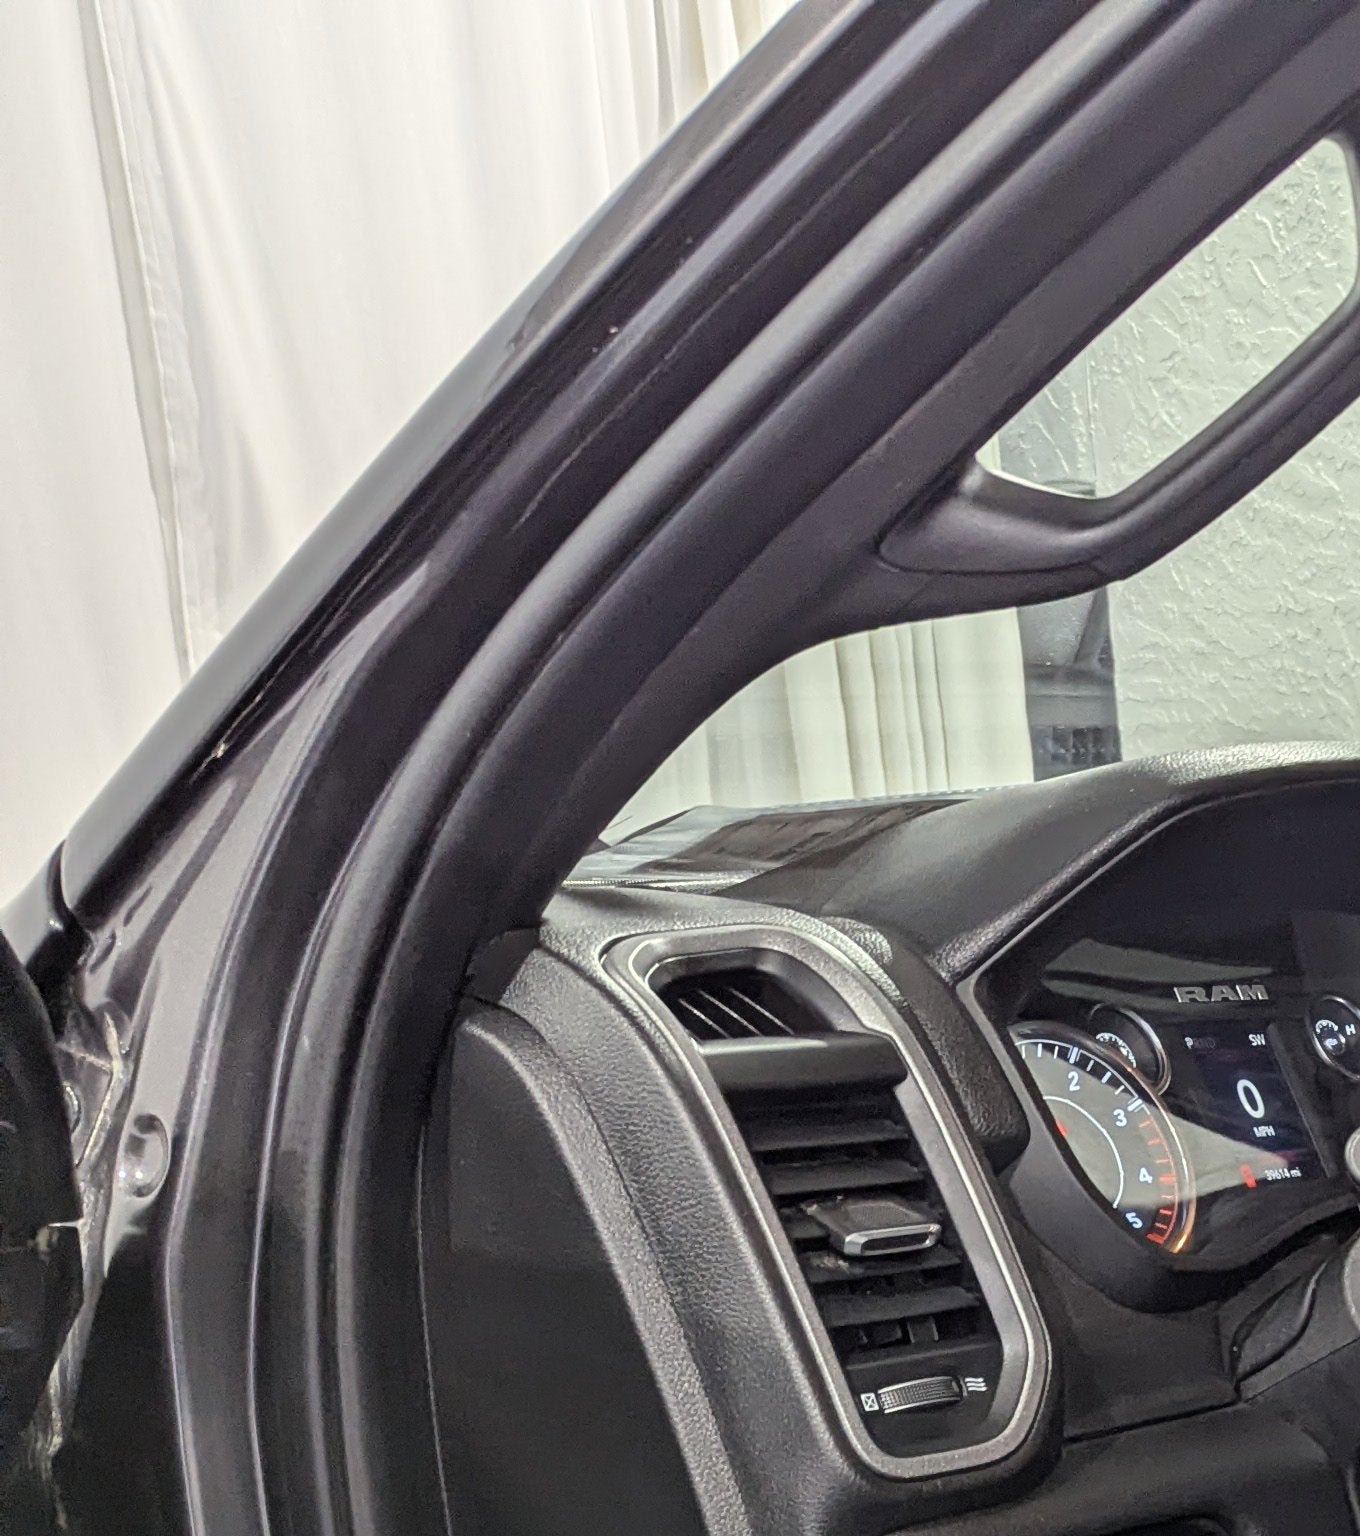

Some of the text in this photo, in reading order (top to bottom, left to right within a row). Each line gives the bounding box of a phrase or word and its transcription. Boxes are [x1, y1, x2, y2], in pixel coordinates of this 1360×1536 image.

[1173, 984, 1269, 1003] RAM
[1345, 1024, 1356, 1035] H
[1248, 1033, 1266, 1047] SW
[1067, 1071, 1081, 1092] 2
[1236, 1079, 1265, 1119] 0
[1113, 1109, 1127, 1127] 3
[1253, 1125, 1275, 1138] MPH
[1139, 1167, 1153, 1184] 4
[1125, 1211, 1143, 1229] 5
